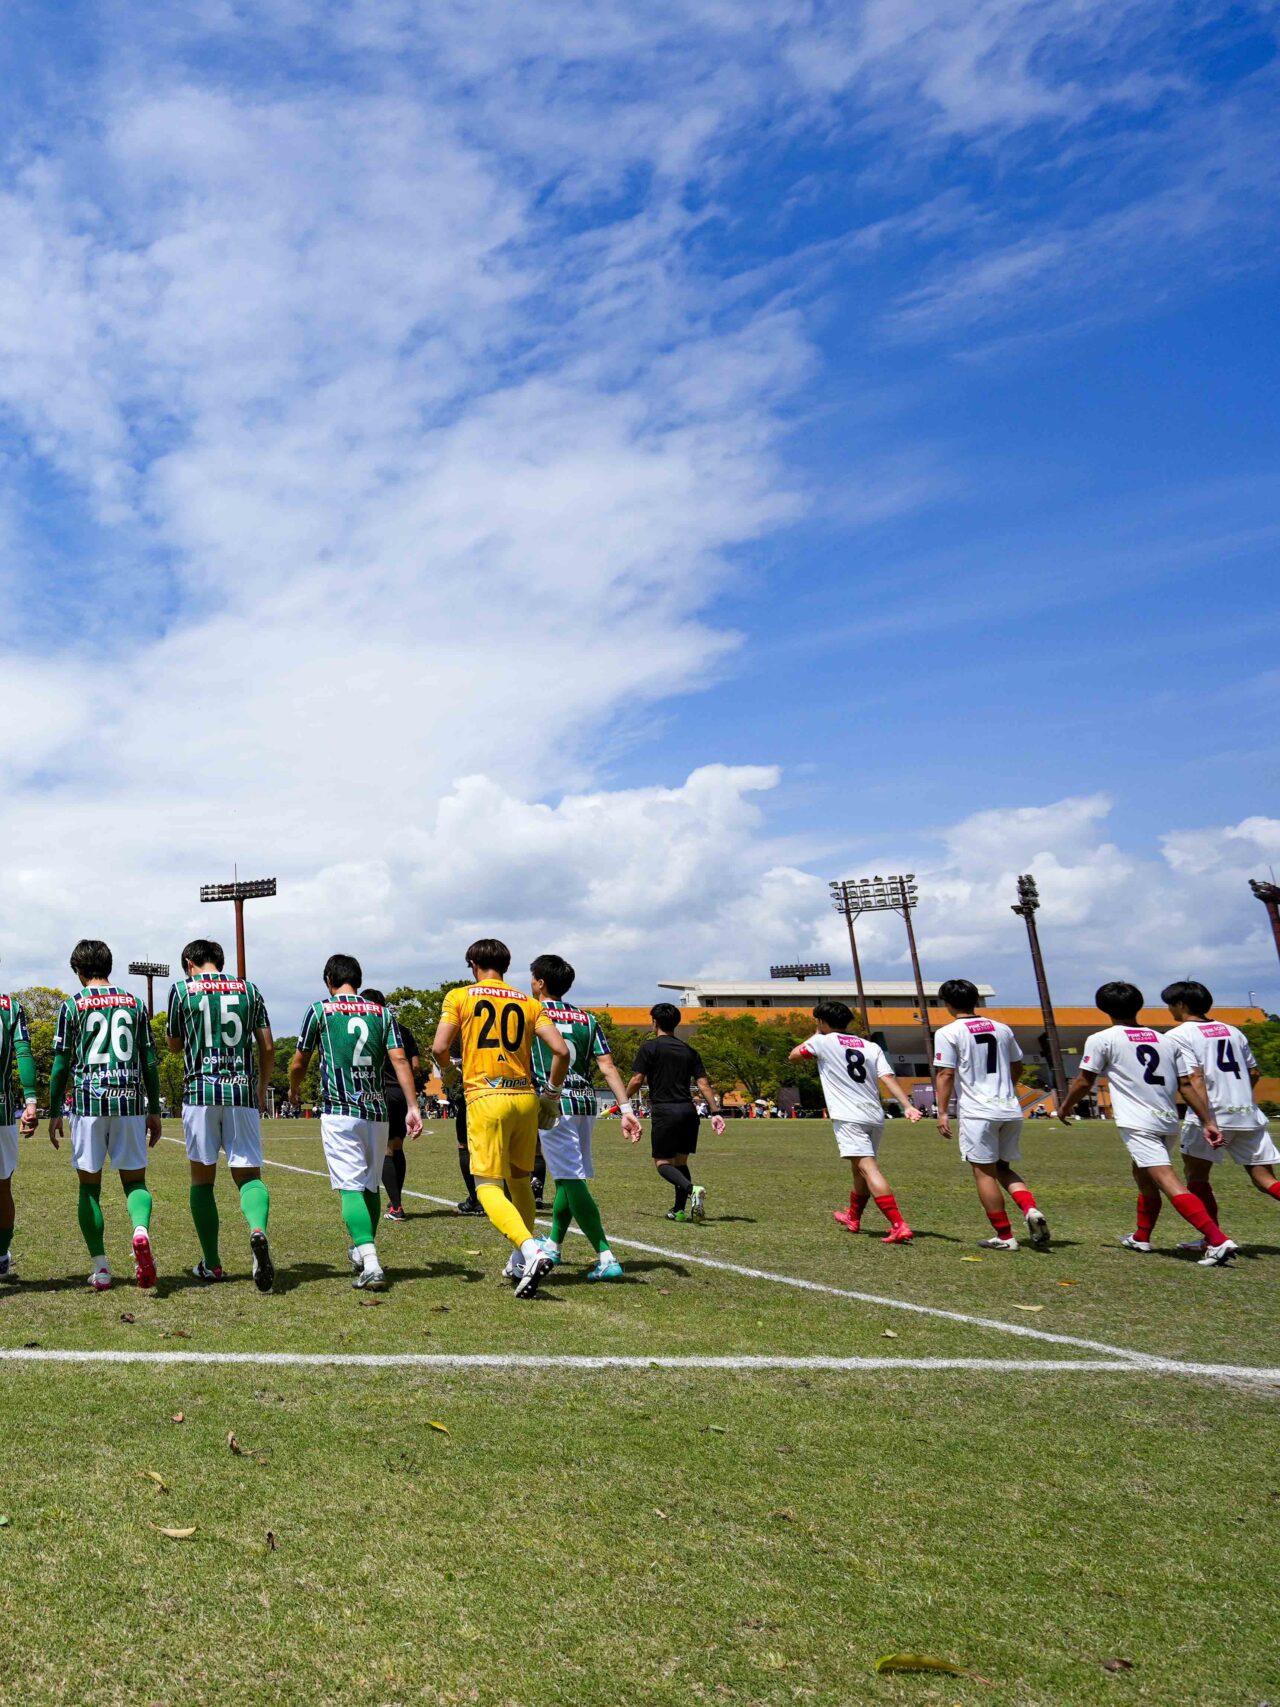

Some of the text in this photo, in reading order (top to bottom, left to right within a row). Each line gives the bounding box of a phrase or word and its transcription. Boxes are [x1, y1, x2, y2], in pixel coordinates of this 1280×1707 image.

[188, 981, 244, 992] FRONTIER
[468, 987, 527, 1001] FRONTIER
[77, 996, 134, 1008] FRONTIER
[325, 1003, 381, 1014] FRONTIER
[198, 995, 243, 1047] 15
[548, 1009, 587, 1022] ONTIER
[474, 999, 525, 1052] 20
[86, 1008, 134, 1065] 26
[347, 1017, 373, 1066] 2
[203, 1055, 243, 1065] OSHIMA
[898, 1055, 905, 1063] C
[974, 1033, 998, 1074] 7
[1217, 1039, 1241, 1080] 4
[845, 1048, 867, 1084] 8
[1136, 1044, 1166, 1087] 2
[82, 1069, 139, 1080] MASAMUNE
[350, 1070, 377, 1079] KURA
